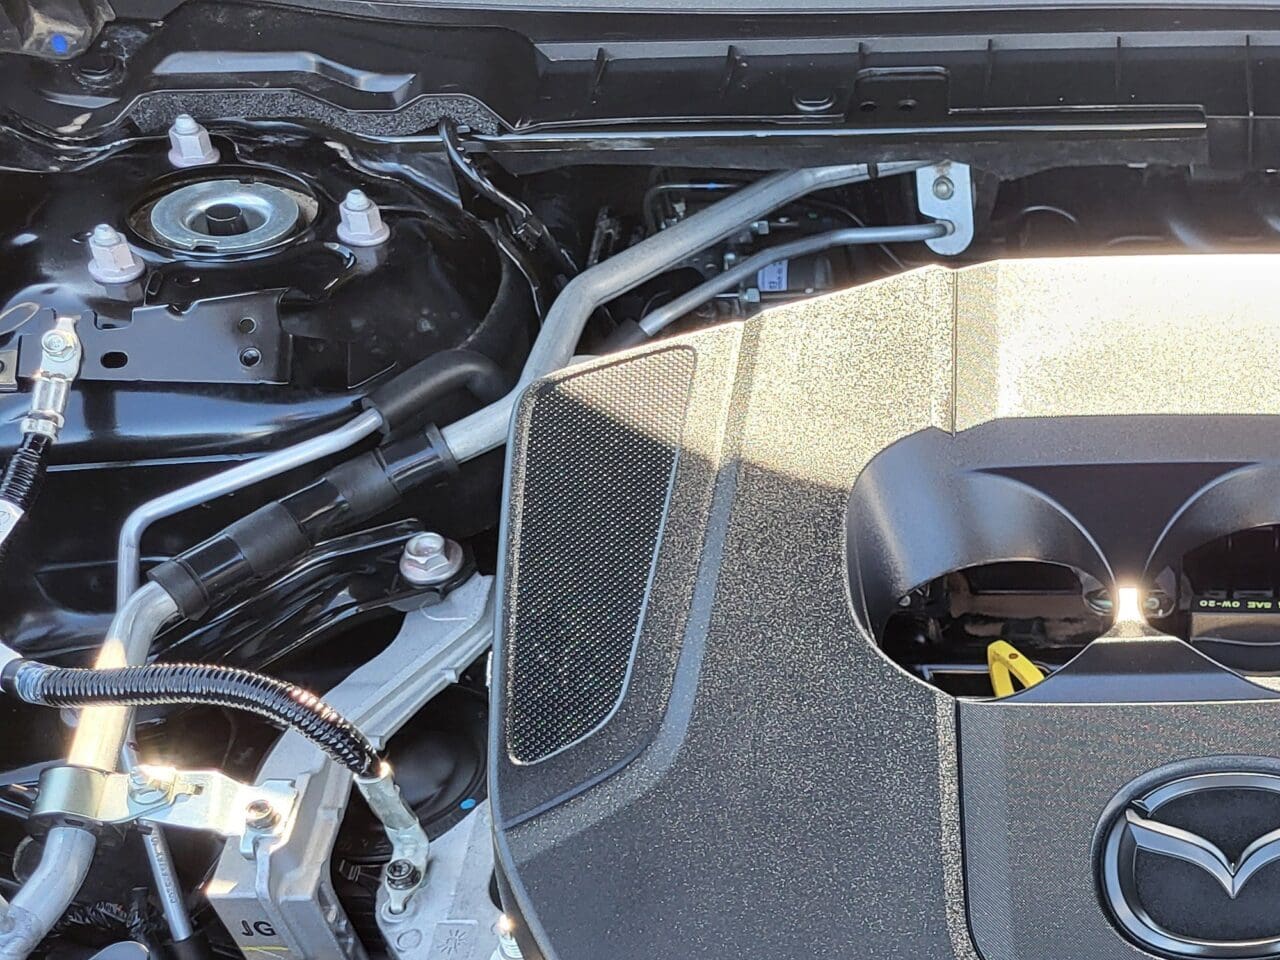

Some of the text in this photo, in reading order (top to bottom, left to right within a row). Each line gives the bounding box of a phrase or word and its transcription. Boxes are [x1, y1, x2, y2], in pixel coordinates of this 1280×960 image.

[1199, 599, 1272, 609] SAE 0W-20
[241, 920, 276, 936] JG
